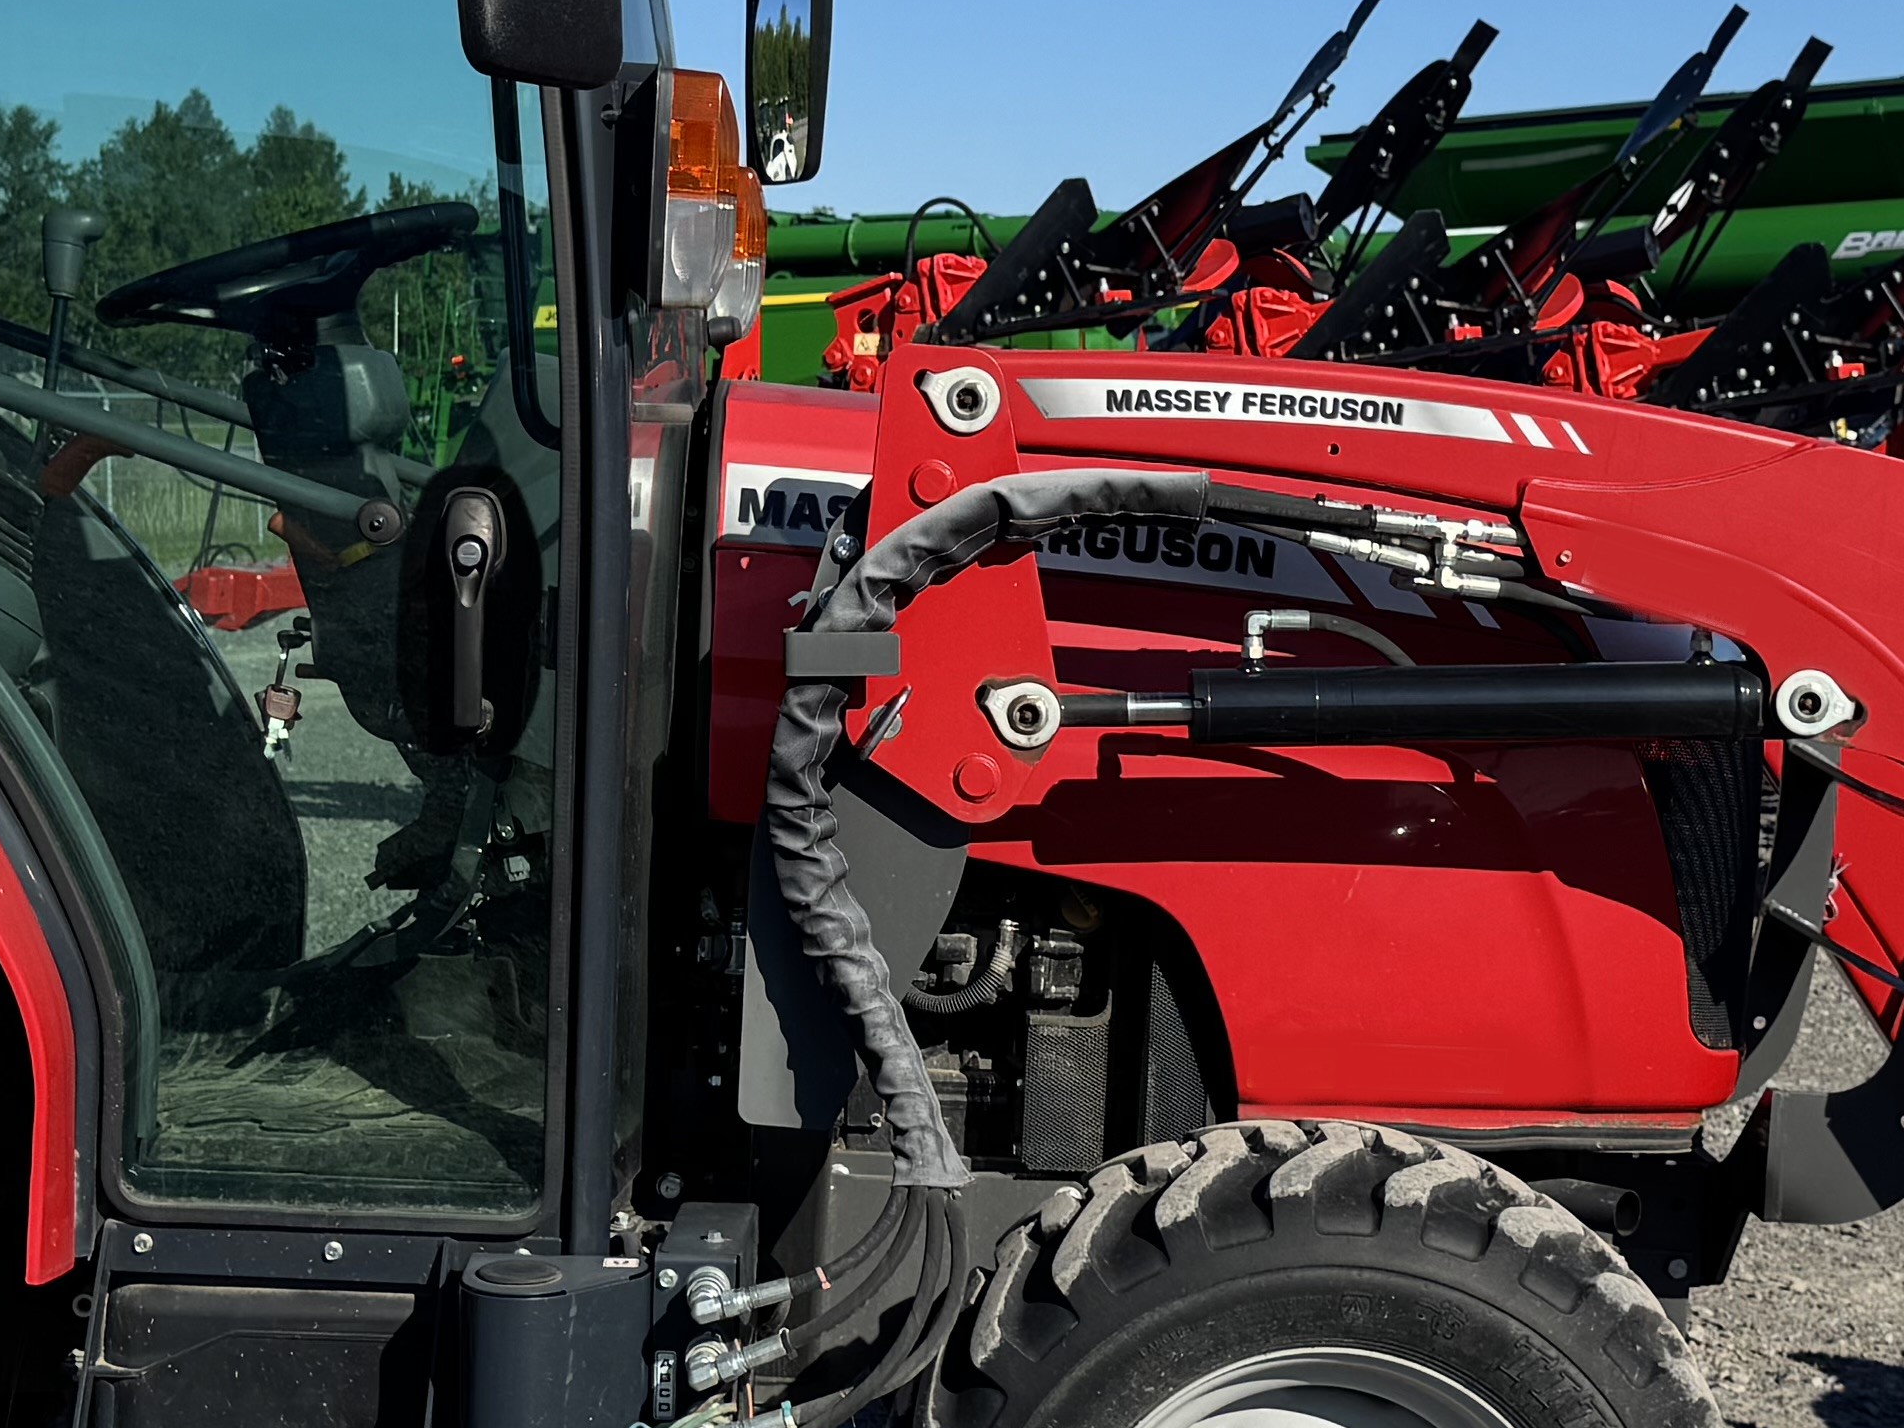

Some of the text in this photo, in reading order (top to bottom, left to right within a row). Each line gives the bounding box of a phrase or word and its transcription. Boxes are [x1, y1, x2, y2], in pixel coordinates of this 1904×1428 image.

[1106, 388, 1405, 426] MASSEY FERGUSON
[737, 487, 1277, 579] MAS RGUSON
